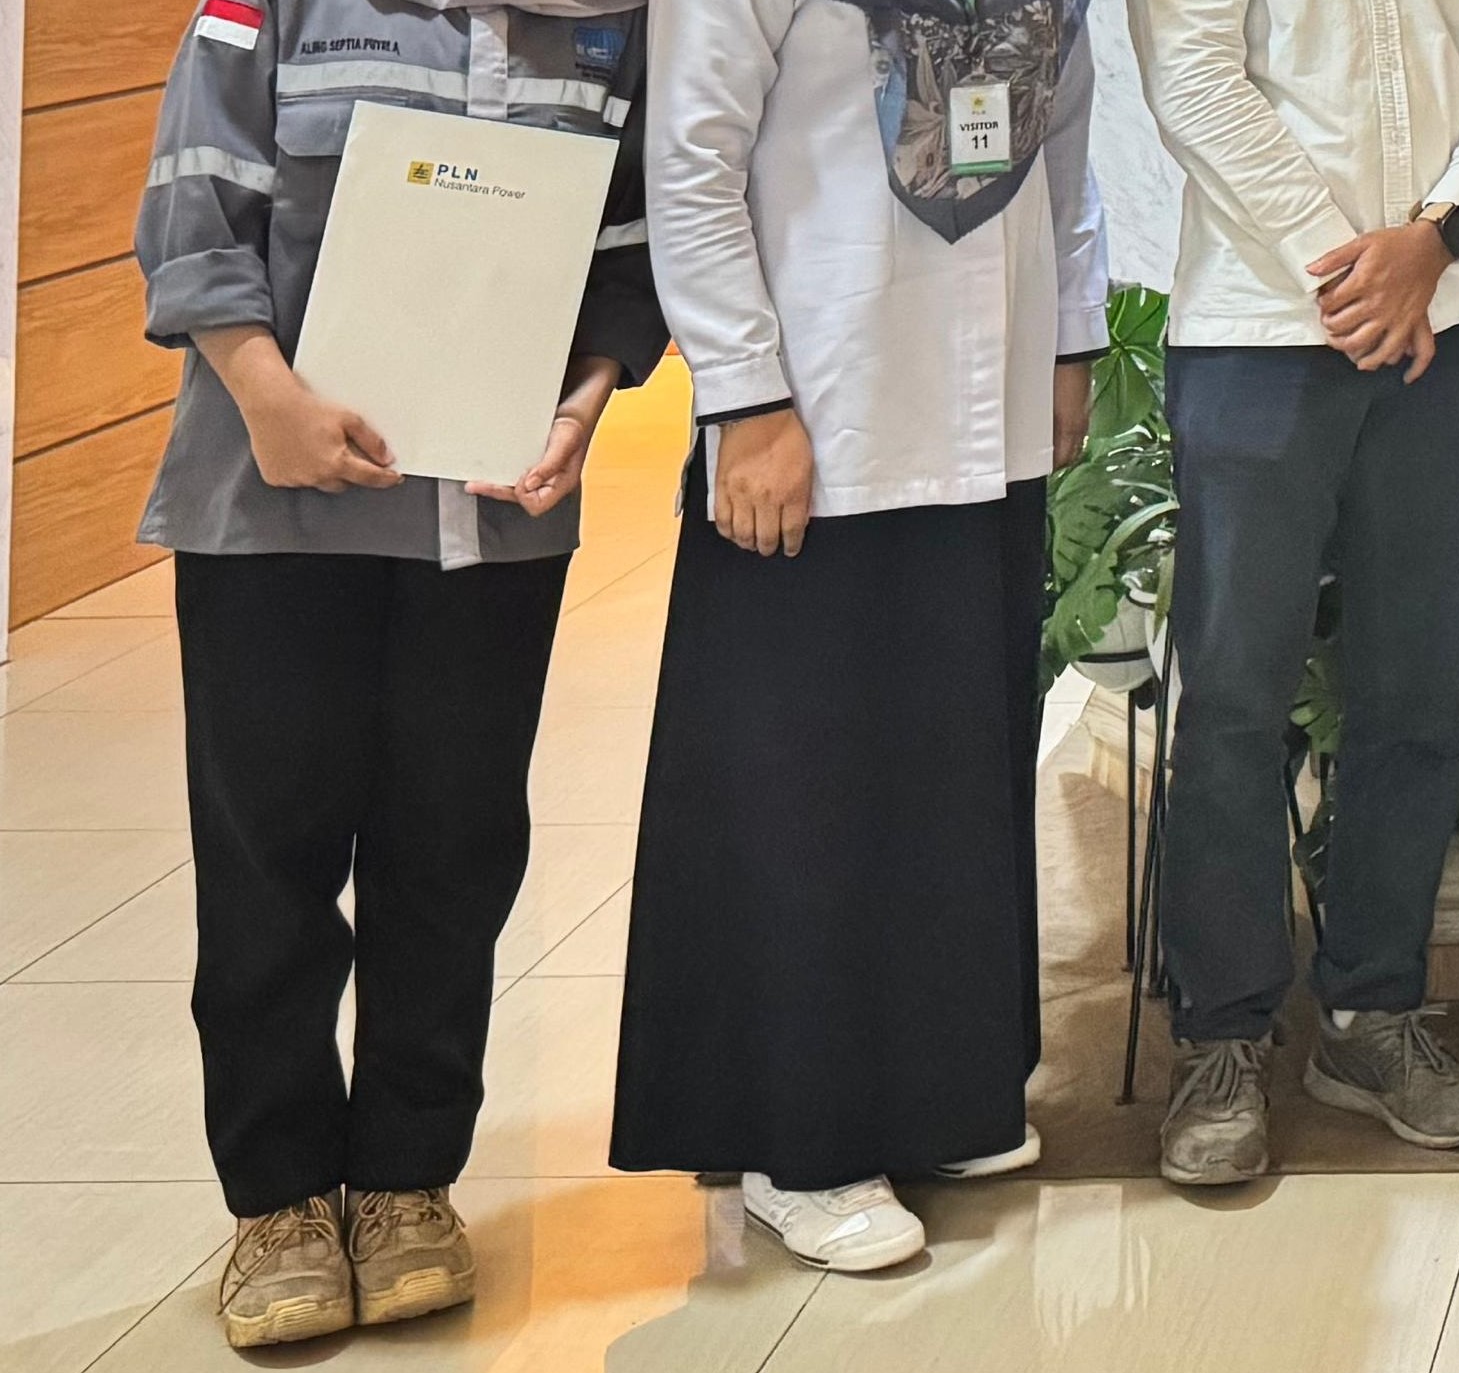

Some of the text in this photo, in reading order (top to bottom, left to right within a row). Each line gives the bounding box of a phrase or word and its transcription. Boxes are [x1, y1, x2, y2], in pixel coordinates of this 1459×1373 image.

[329, 37, 361, 52] SEPTIA
[960, 121, 999, 132] VISITOR
[971, 133, 988, 149] 11
[437, 164, 478, 181] PLN
[434, 178, 526, 200] Nusantara Power
